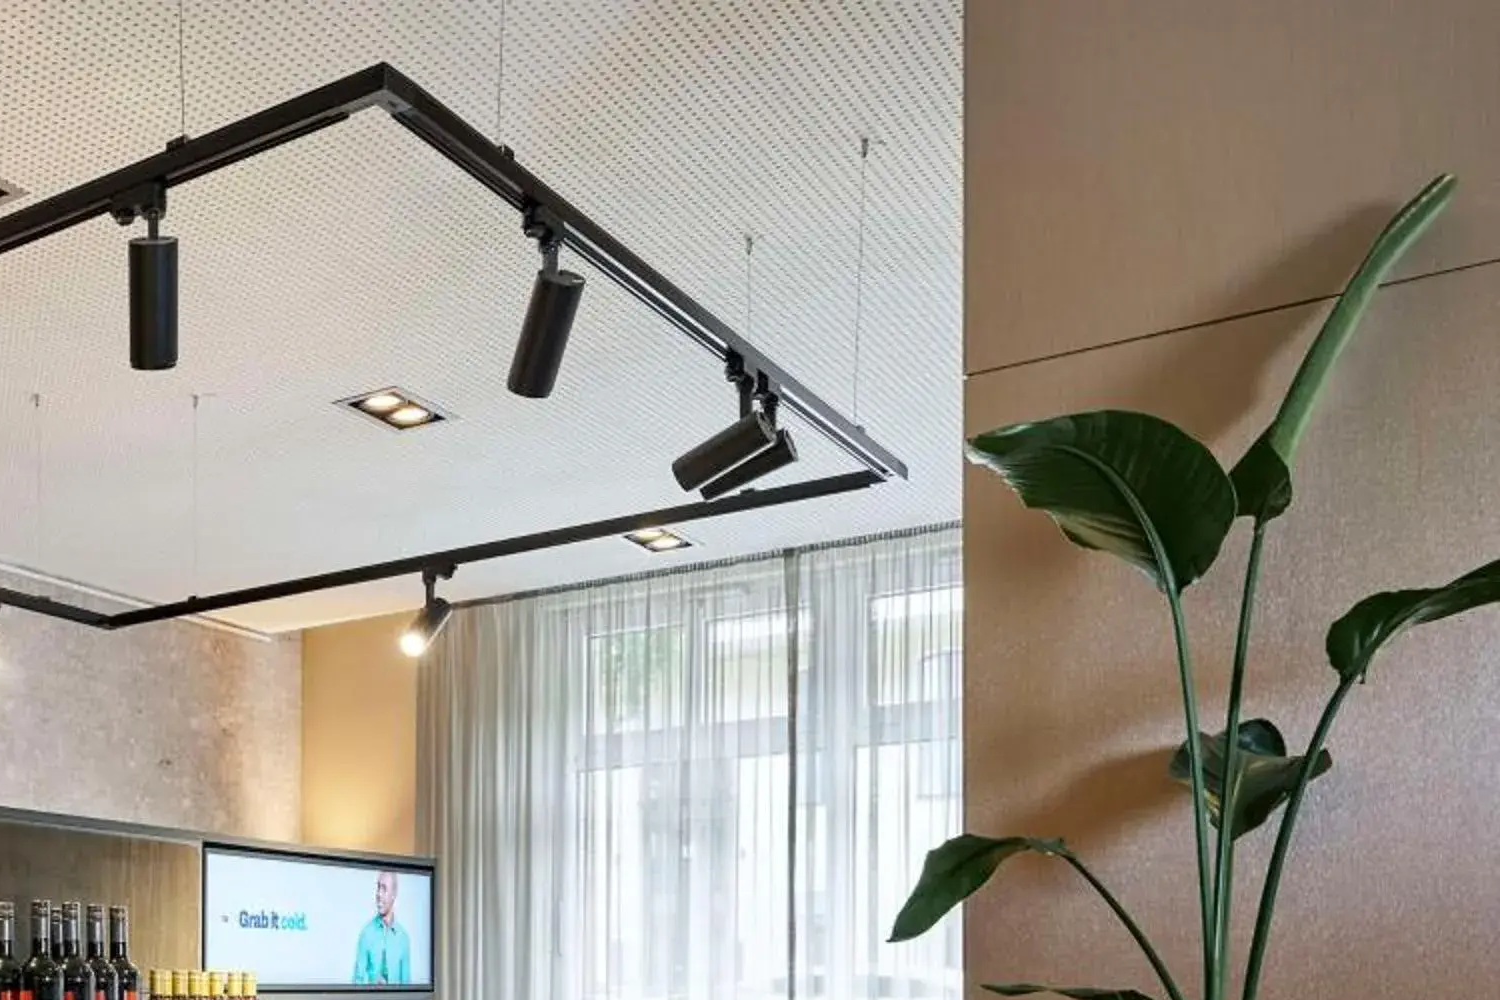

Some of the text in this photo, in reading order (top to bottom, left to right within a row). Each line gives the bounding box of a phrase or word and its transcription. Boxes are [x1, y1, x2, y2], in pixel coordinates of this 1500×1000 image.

[239, 910, 308, 931] Grab it cold.
